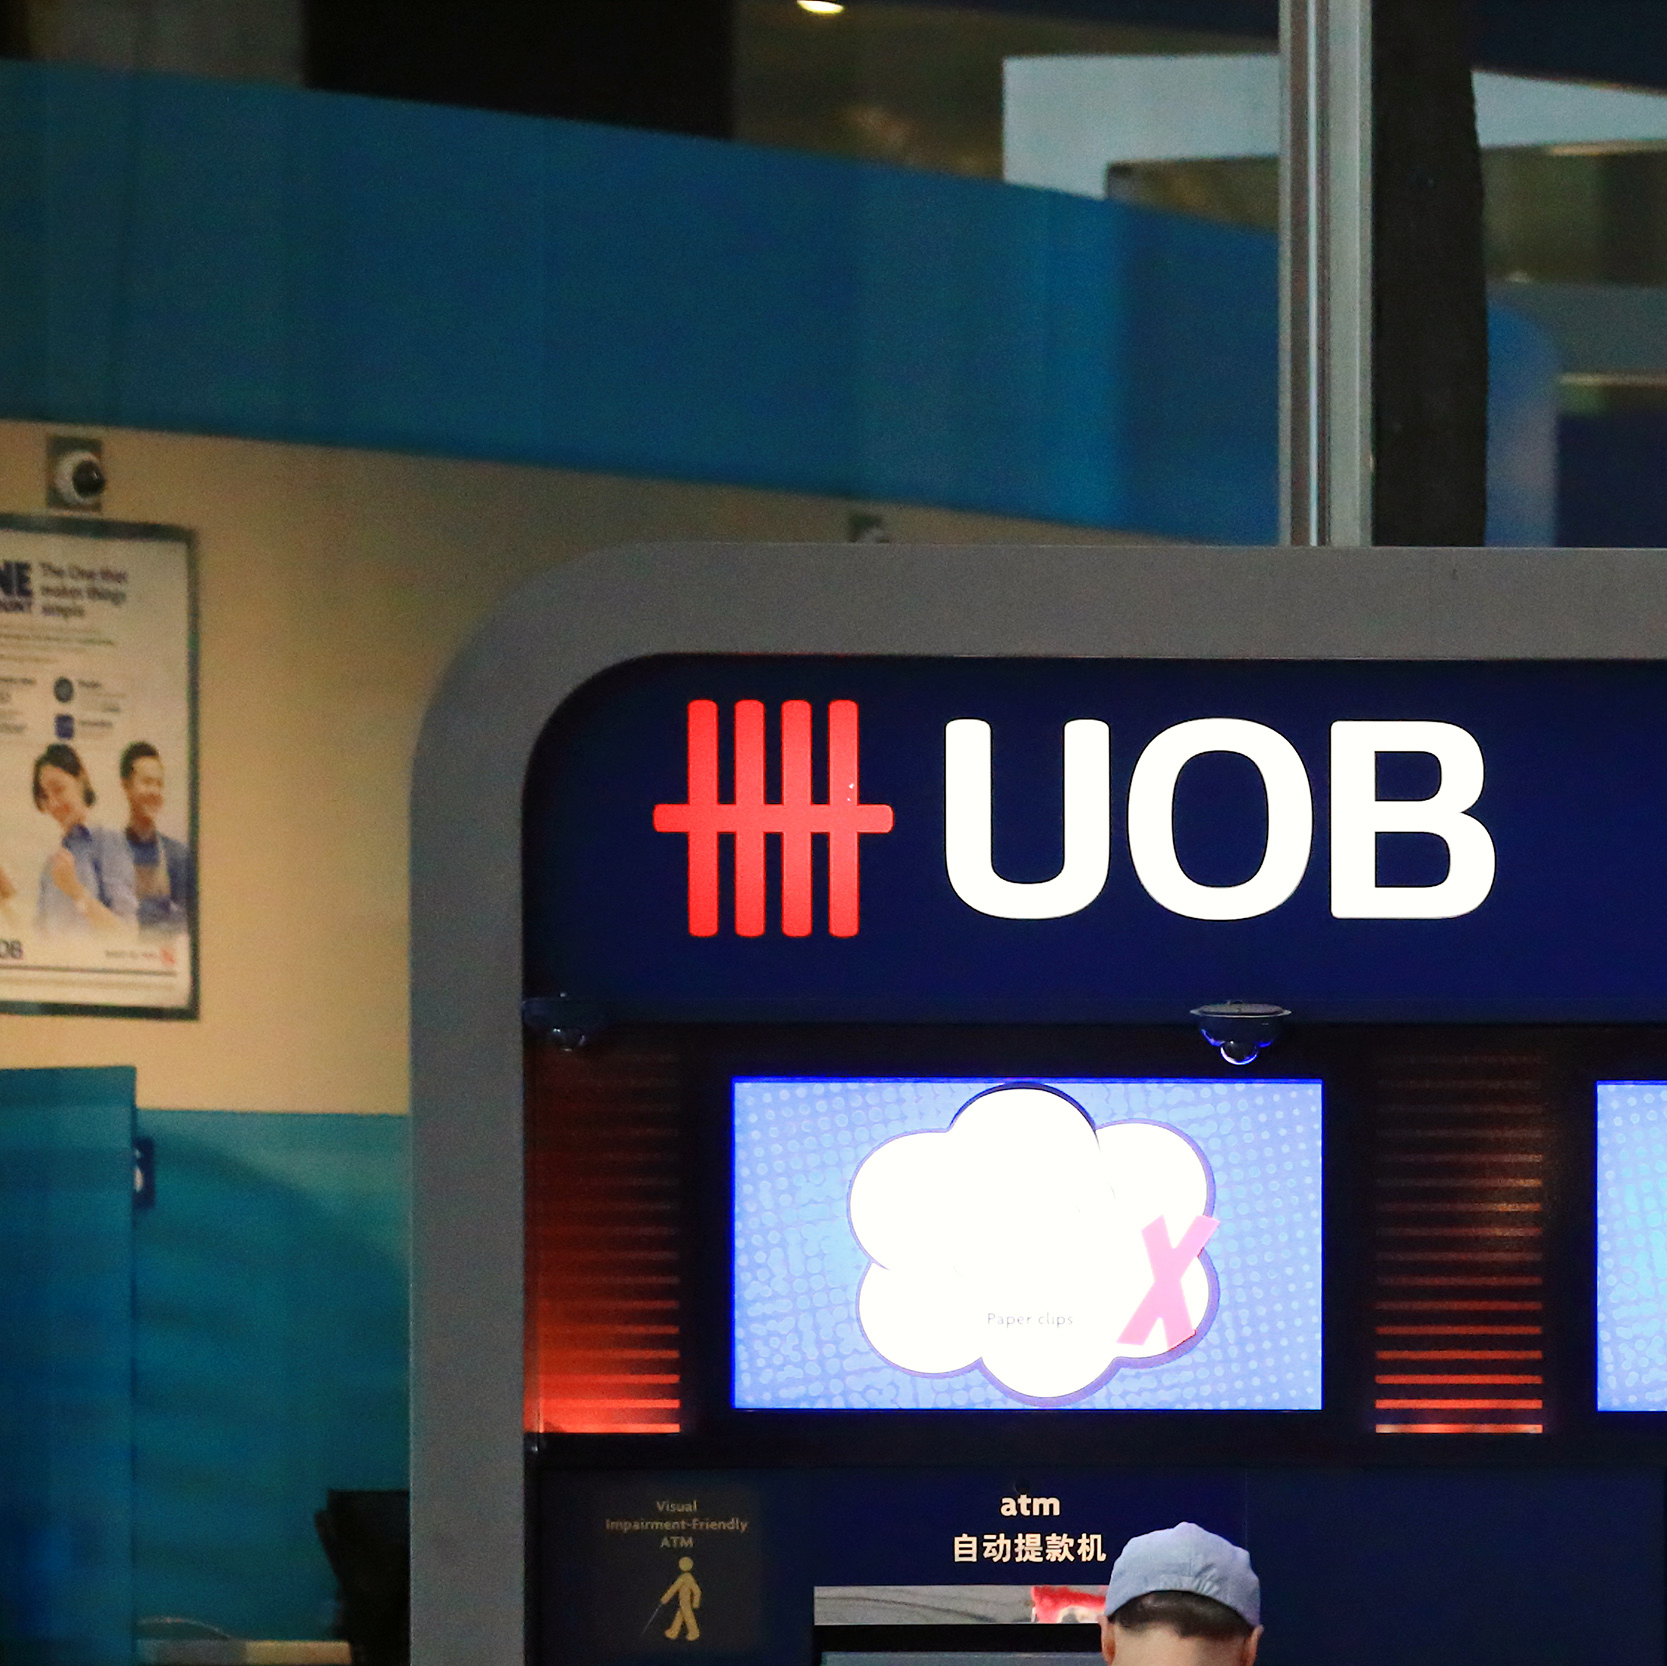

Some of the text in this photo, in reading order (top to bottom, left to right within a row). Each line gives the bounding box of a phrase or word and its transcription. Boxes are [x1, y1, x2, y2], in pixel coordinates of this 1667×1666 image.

[943, 717, 1497, 921] UOB
[987, 1311, 1073, 1329] Paper clips
[656, 1500, 698, 1513] Visual
[1000, 1494, 1061, 1517] atm
[605, 1517, 749, 1533] Impairment-Friendly
[659, 1536, 694, 1548] ATM
[953, 1533, 1107, 1563] 自动提款机
